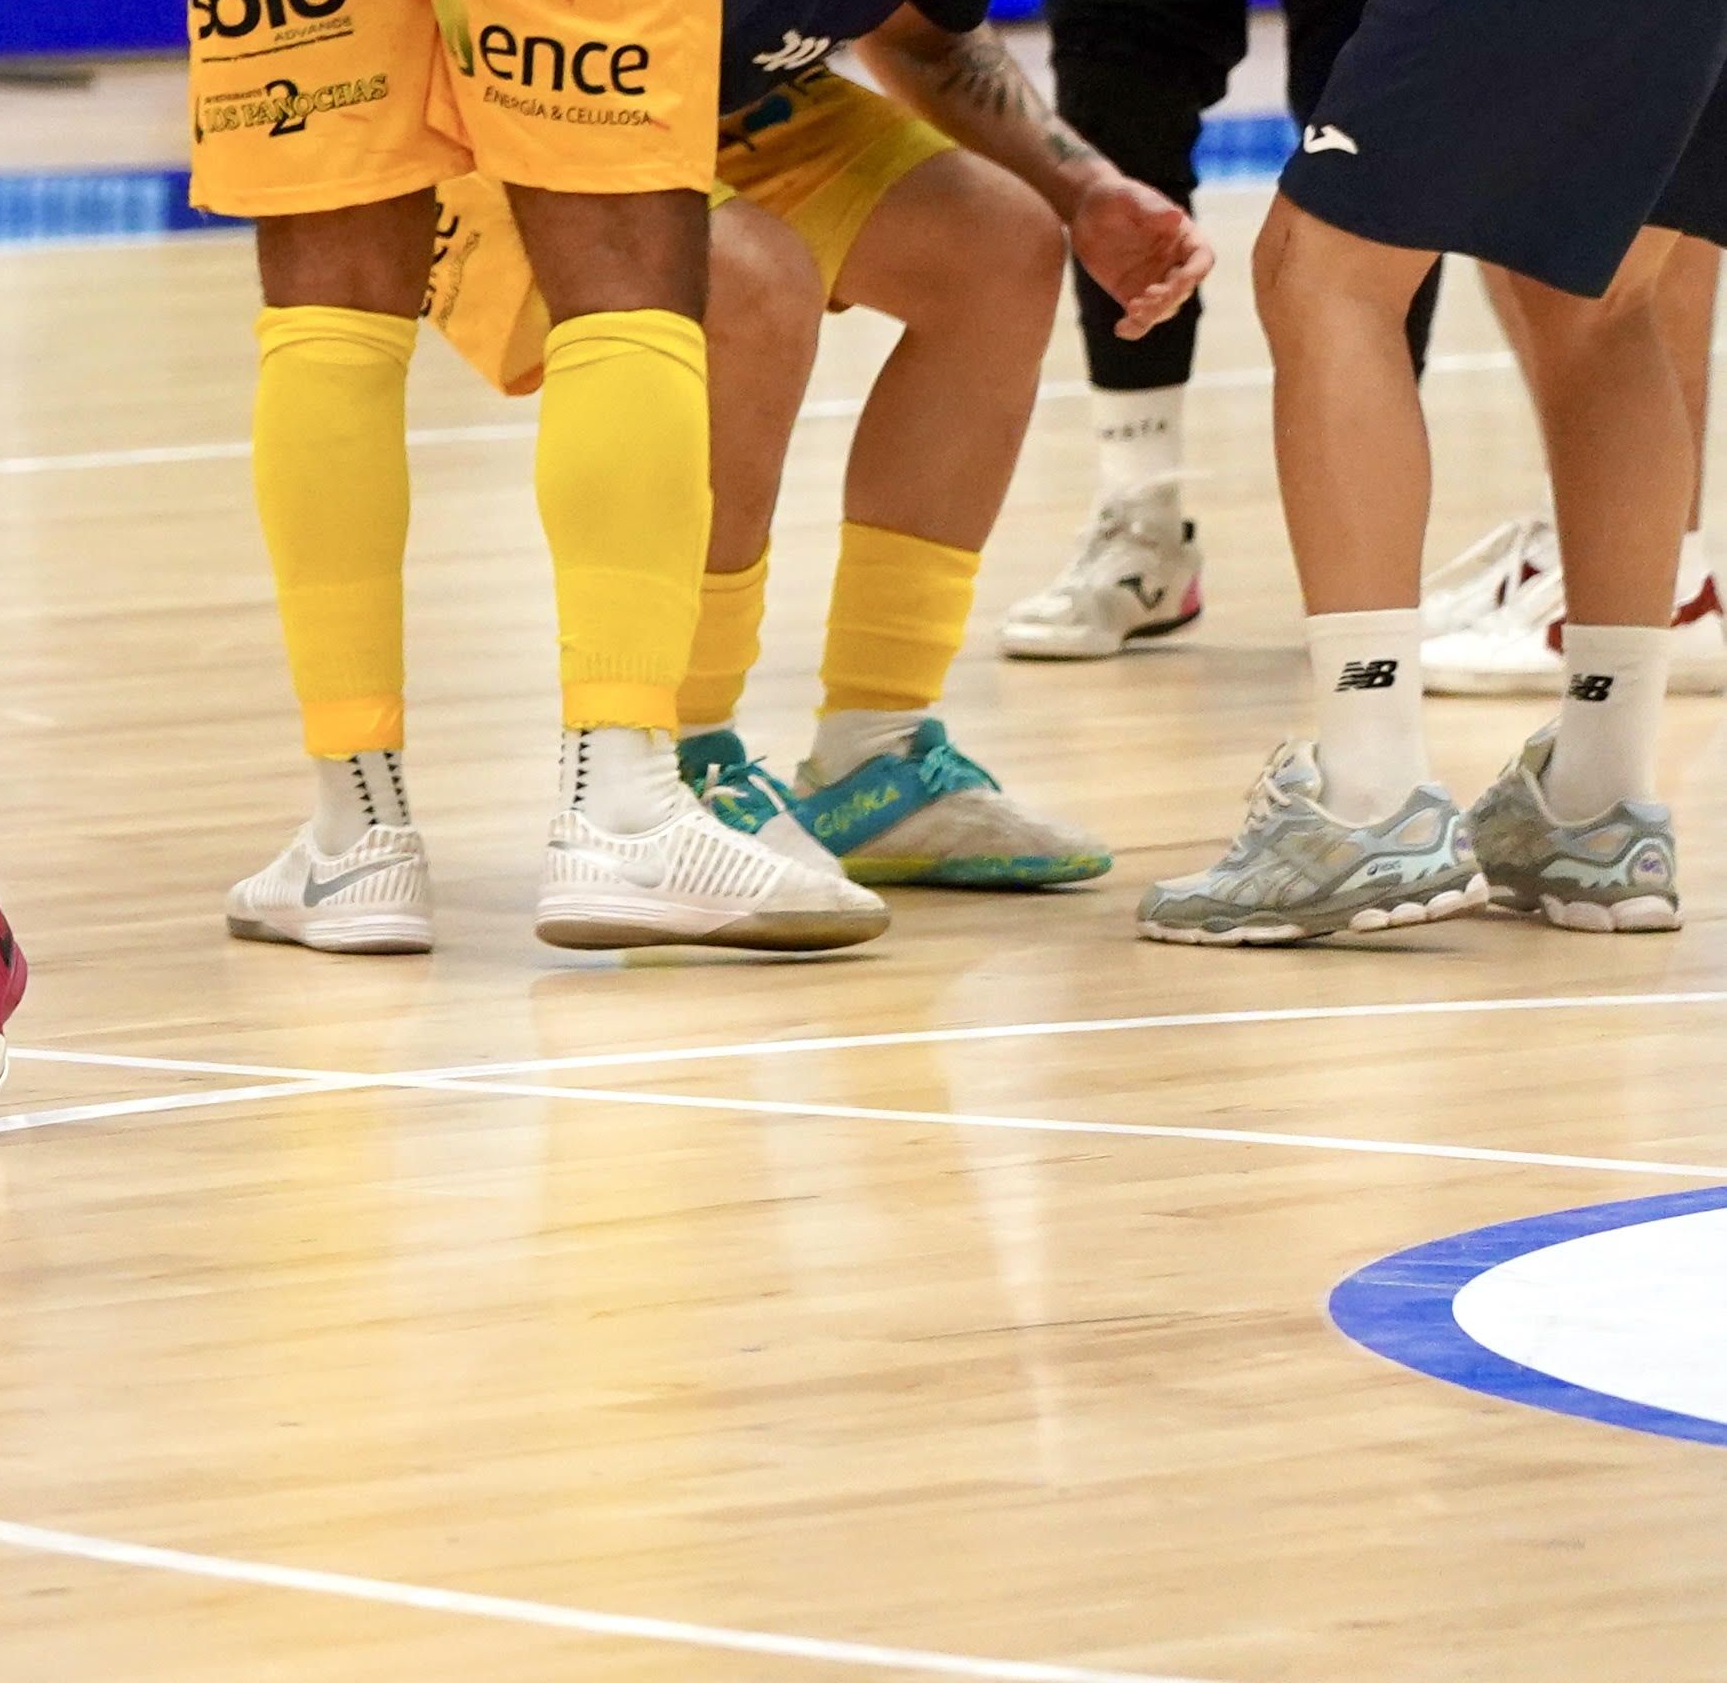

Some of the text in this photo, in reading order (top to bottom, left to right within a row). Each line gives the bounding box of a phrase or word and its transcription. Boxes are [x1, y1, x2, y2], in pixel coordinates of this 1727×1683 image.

[479, 24, 650, 96] ence
[550, 105, 563, 121] &
[566, 106, 653, 127] CELULOSA
